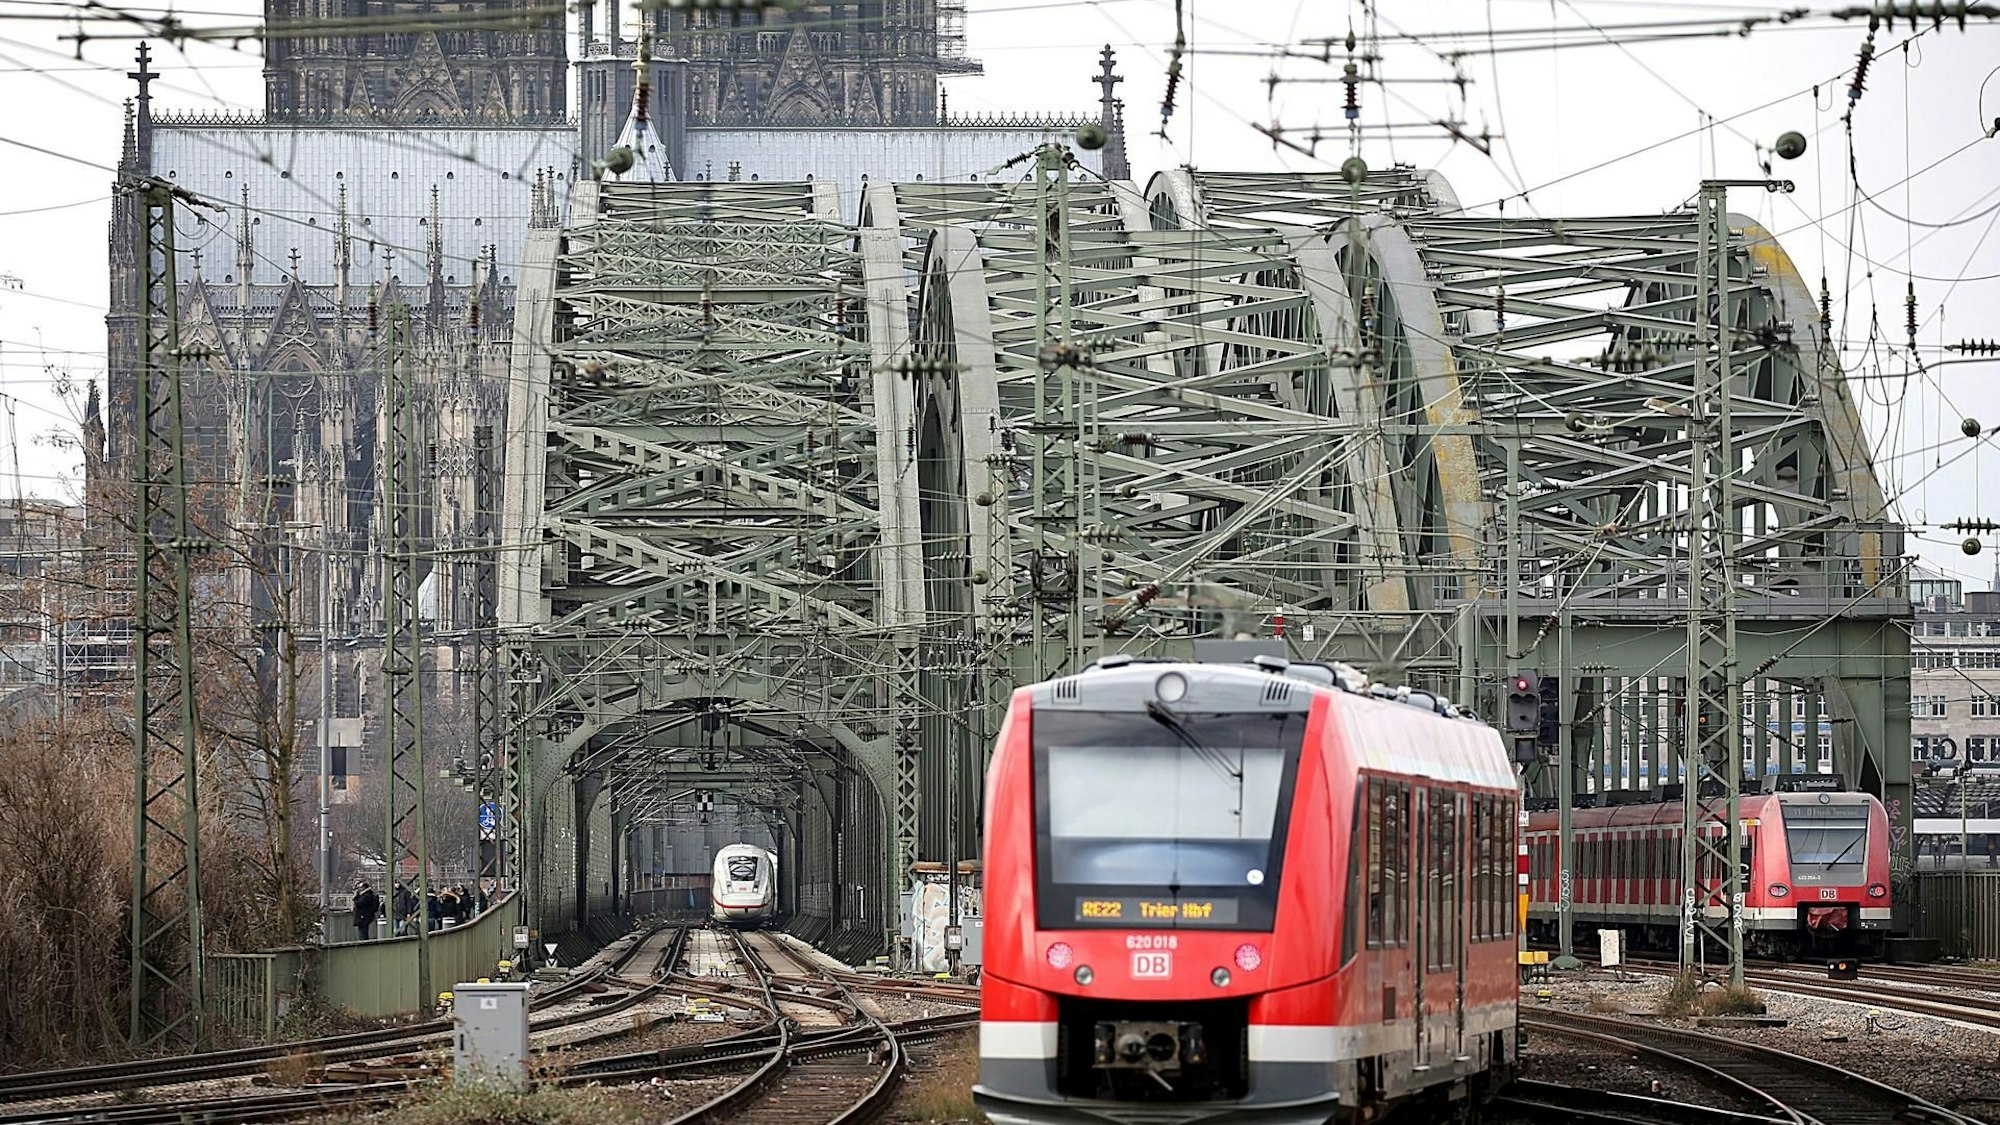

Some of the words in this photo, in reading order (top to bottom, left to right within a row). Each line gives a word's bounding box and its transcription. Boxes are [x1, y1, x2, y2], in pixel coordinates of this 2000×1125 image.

[1821, 889, 1836, 899] DB
[1082, 901, 1121, 917] RE22
[1140, 902, 1178, 919] Trier
[1182, 903, 1213, 919] Hbf
[1126, 935, 1151, 949] 620
[1153, 935, 1178, 949] 018
[1135, 954, 1167, 975] DB
